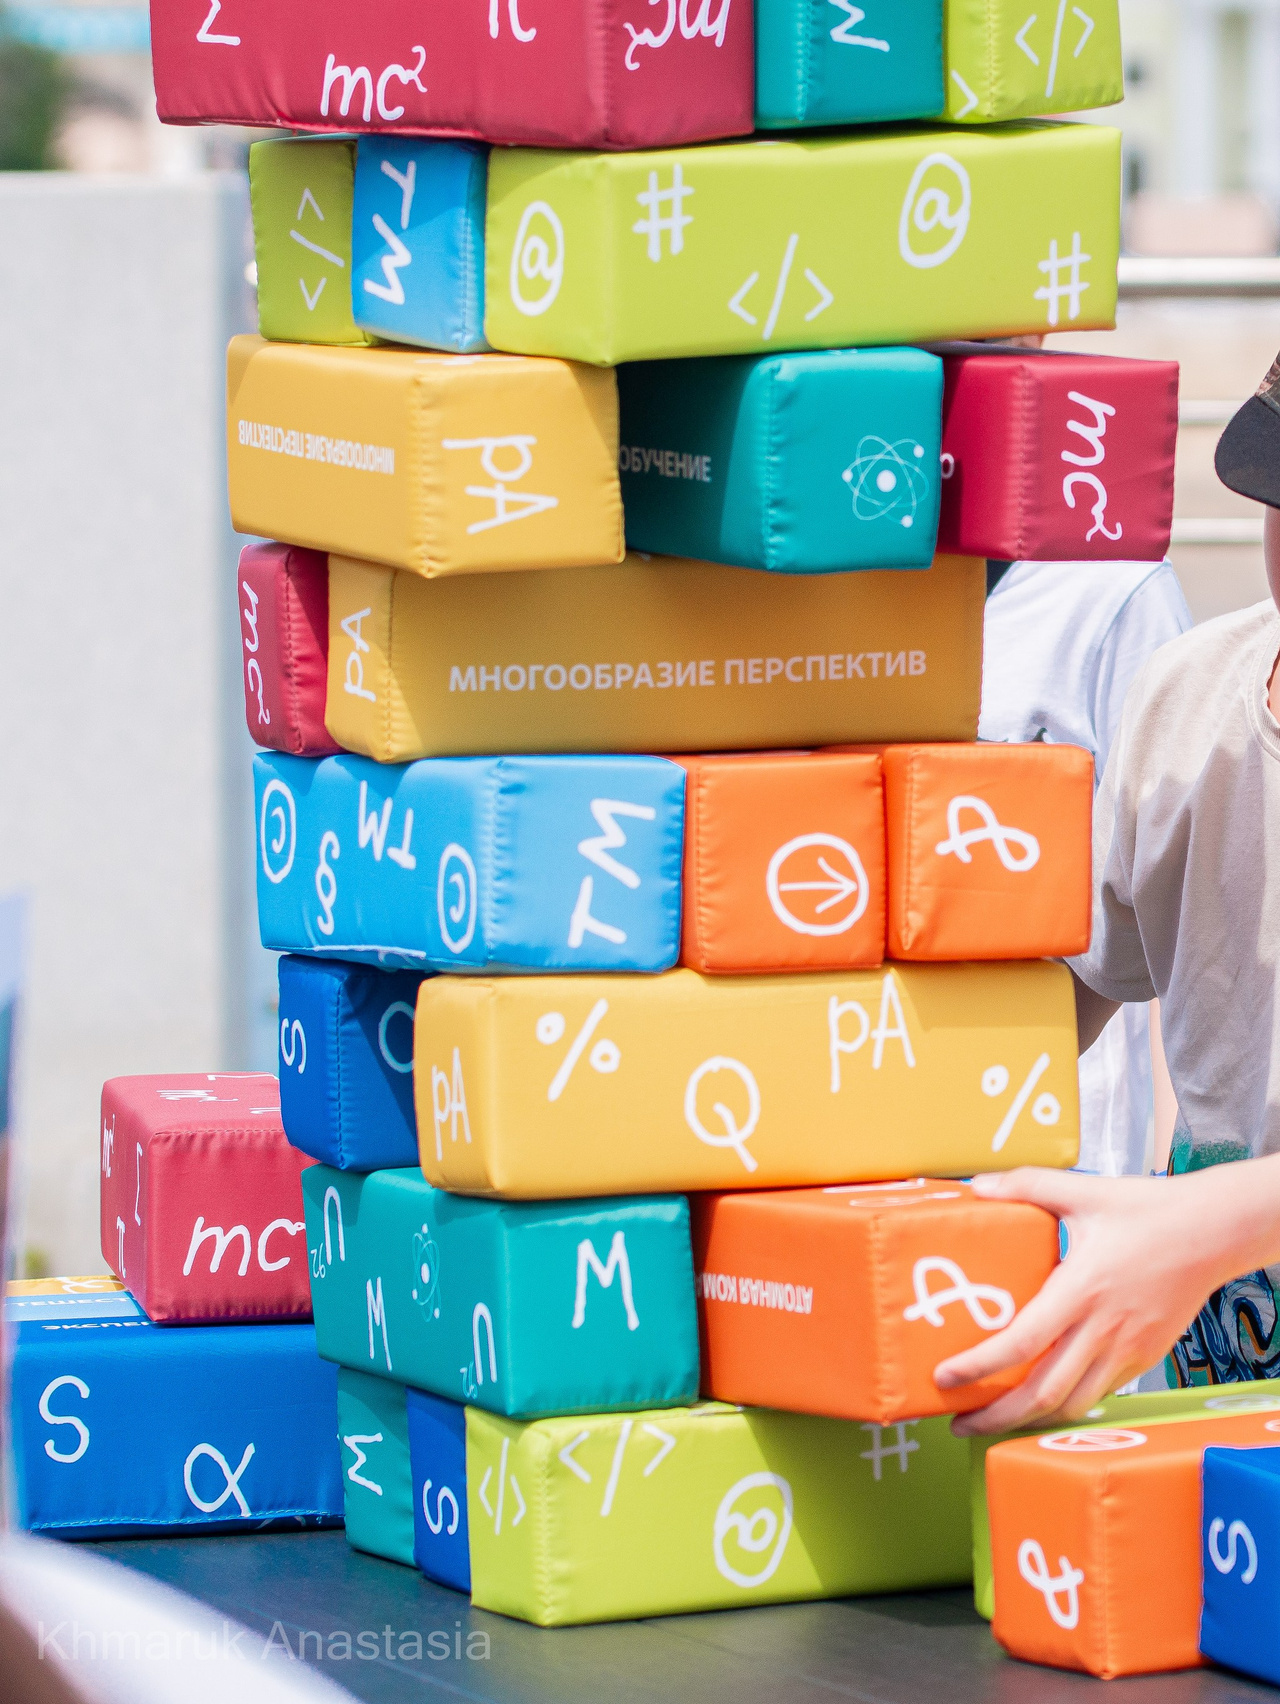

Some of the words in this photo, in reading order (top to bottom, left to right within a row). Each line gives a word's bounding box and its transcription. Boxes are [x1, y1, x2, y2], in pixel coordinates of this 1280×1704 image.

[238, 419, 304, 458] ПЕРСПЕКТИВ
[304, 432, 395, 475] МНОГООБРАЗИЕ
[618, 444, 712, 483] ОБУЧЕНИЕ
[449, 660, 715, 692] МНОГООБРАЗИЕ
[724, 650, 927, 685] ПЕРСПЕКТИВ
[183, 1216, 305, 1277] mc
[696, 1272, 737, 1303] КОМ
[739, 1277, 813, 1315] АТОМНАЯ
